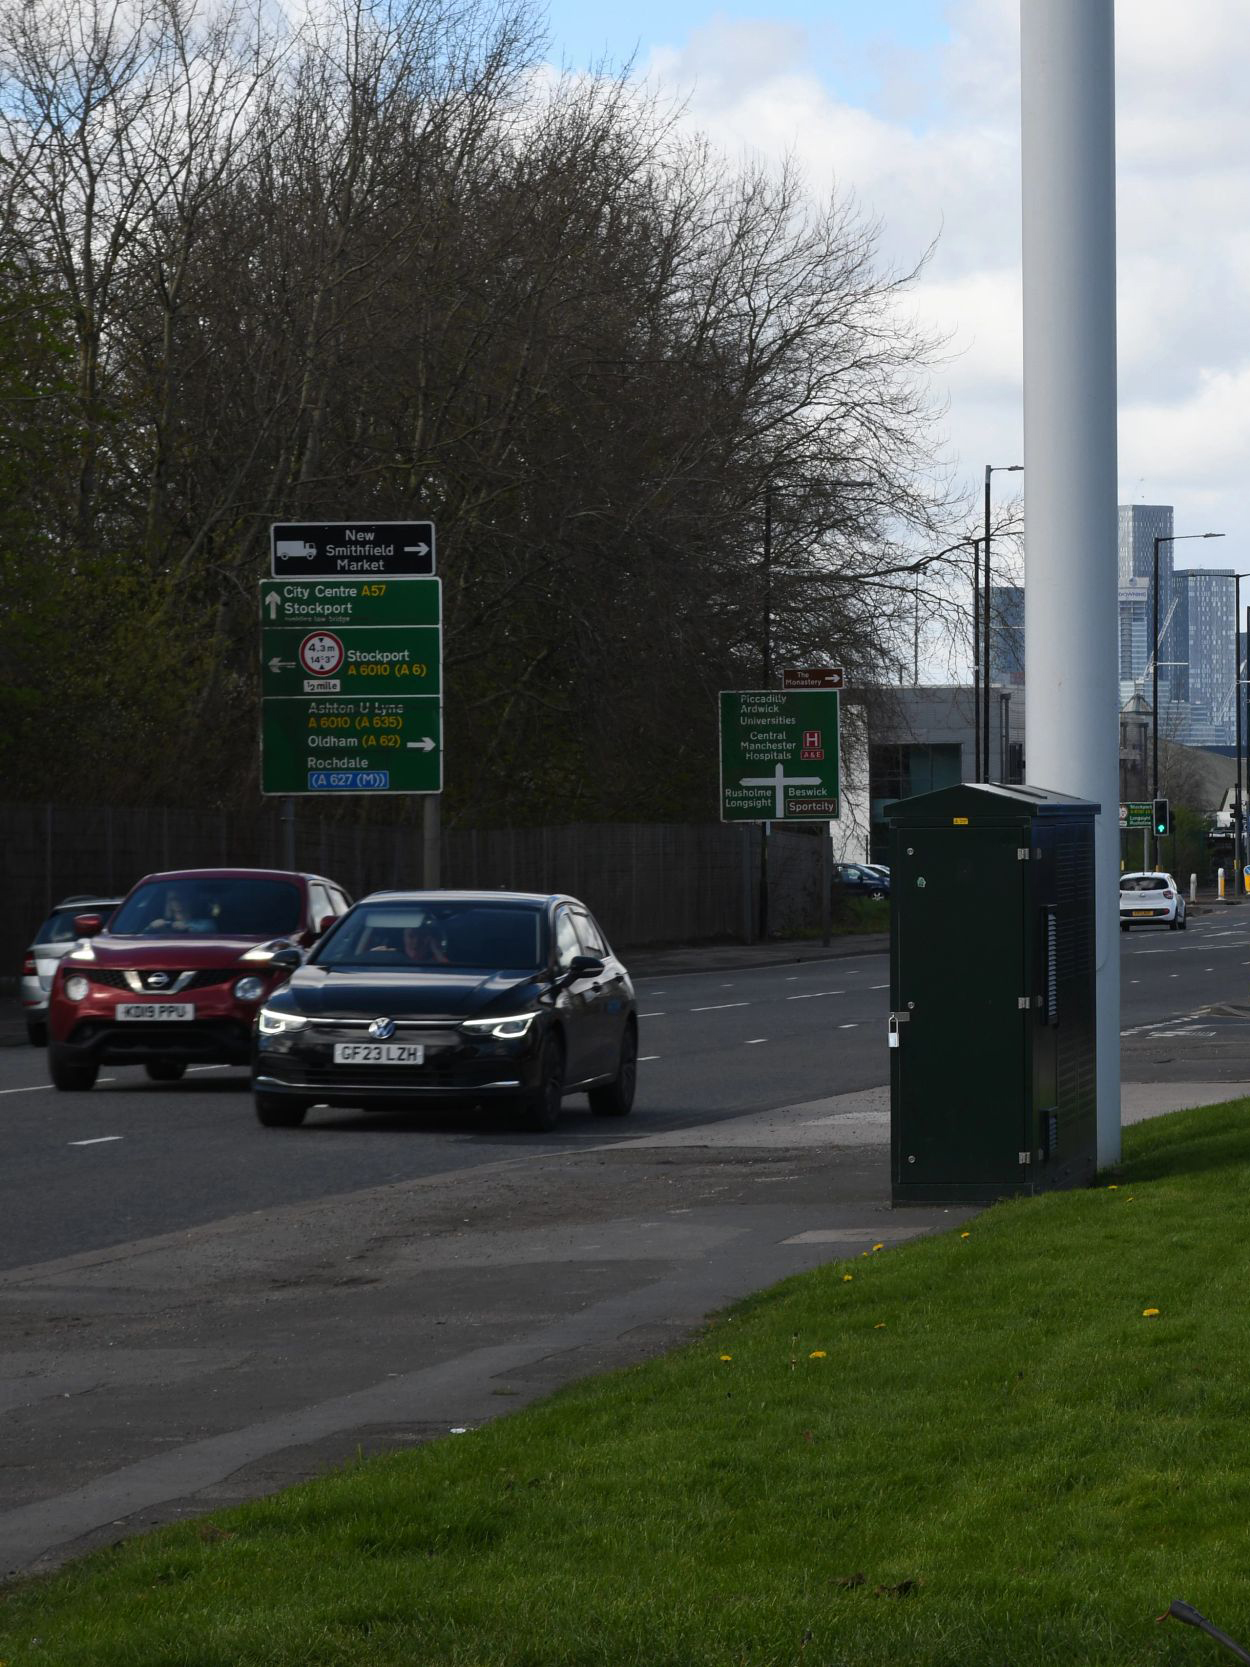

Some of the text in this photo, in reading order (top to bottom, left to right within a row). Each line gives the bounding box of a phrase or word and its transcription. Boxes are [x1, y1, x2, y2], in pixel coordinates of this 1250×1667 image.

[345, 529, 375, 541] New
[326, 544, 394, 556] Smithfield
[336, 559, 385, 571] Market
[283, 584, 387, 599] City Centre A57
[283, 602, 353, 616] Stockport
[347, 649, 410, 662] Stockport
[347, 664, 427, 677] A 6010 (A 6)
[740, 694, 787, 704] Piccadilly
[308, 702, 354, 714] Ashton
[374, 702, 404, 715] Lyne
[740, 704, 779, 713] Ardwick
[308, 717, 403, 730] A 6010 (A 635)
[740, 716, 797, 725] Universities
[307, 735, 401, 748] Oldham (A 62)
[740, 741, 797, 750] Manchester
[750, 731, 818, 747] Central H
[307, 756, 369, 769] Rochdale
[745, 751, 792, 761] Hospitals
[311, 773, 385, 787] (A 627 (M))
[725, 787, 828, 797] Rusholme Beswick
[725, 798, 834, 812] Longsight Sportcity
[159, 1005, 187, 1018] PPU
[341, 1045, 418, 1062] GF23 LZH
